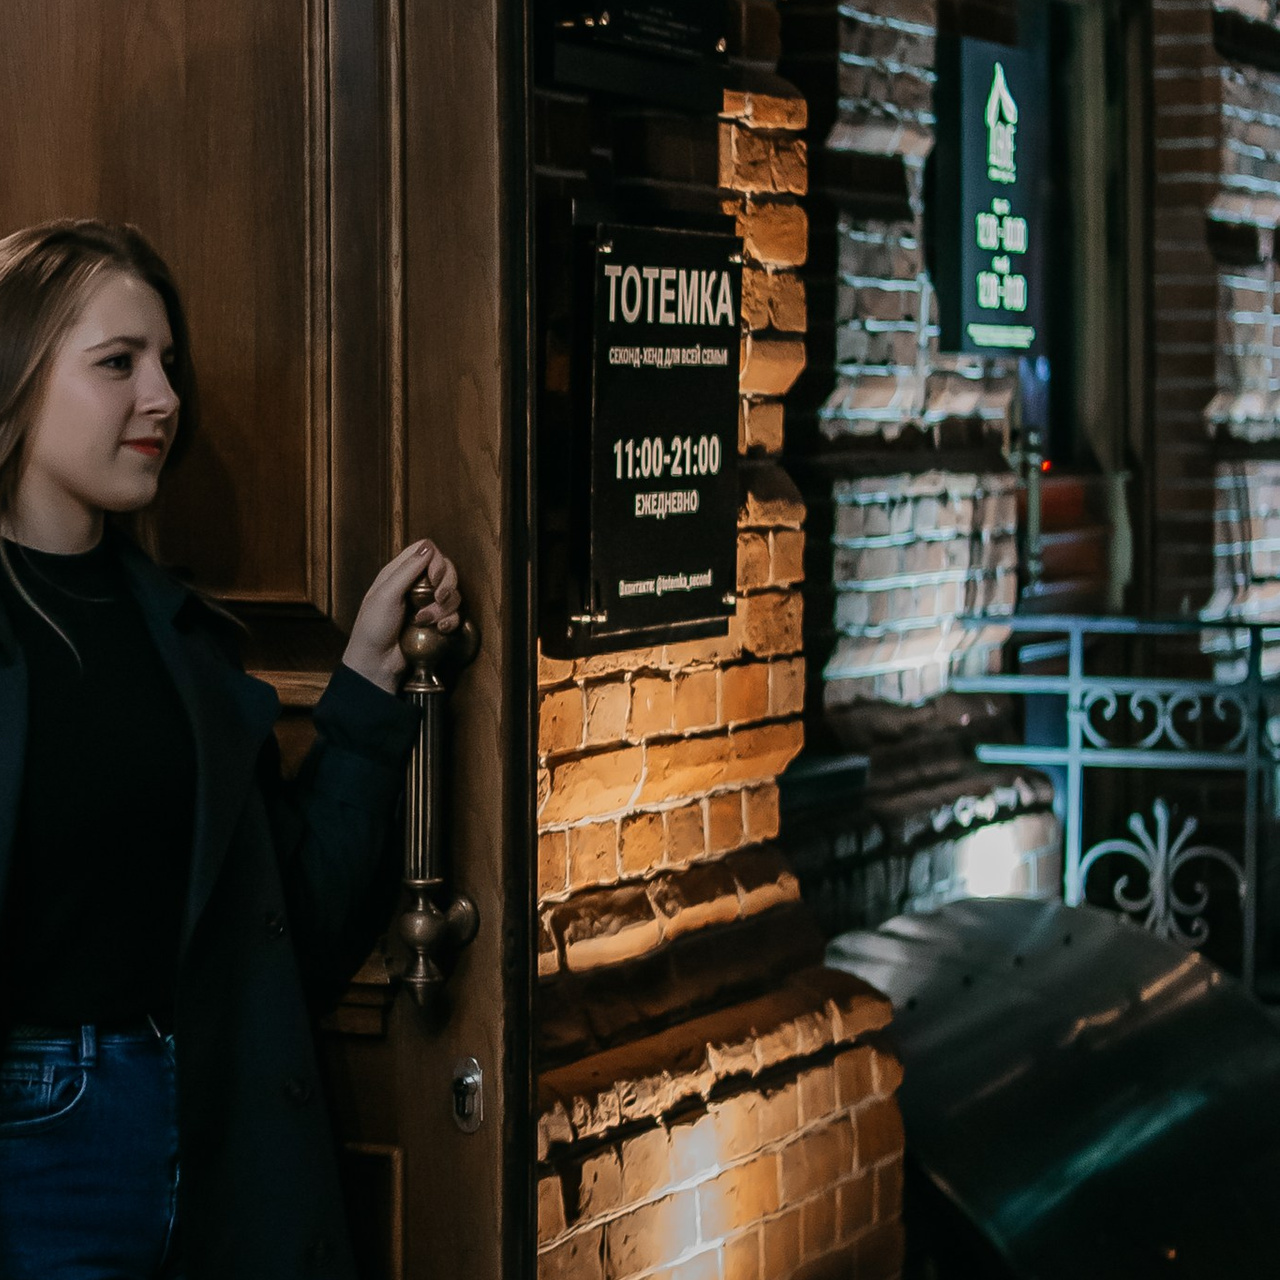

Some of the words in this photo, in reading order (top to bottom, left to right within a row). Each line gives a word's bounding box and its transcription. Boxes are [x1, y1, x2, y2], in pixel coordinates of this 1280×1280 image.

[604, 264, 736, 327] ТОТЕМКА
[609, 346, 664, 368] СЕКОНД-ХЕНД
[663, 347, 680, 369] ДЛЯ
[681, 343, 701, 365] ВСЕЙ
[613, 434, 722, 479] 11:00-21:00
[635, 489, 699, 519] ЕЖЕДНЕВНО
